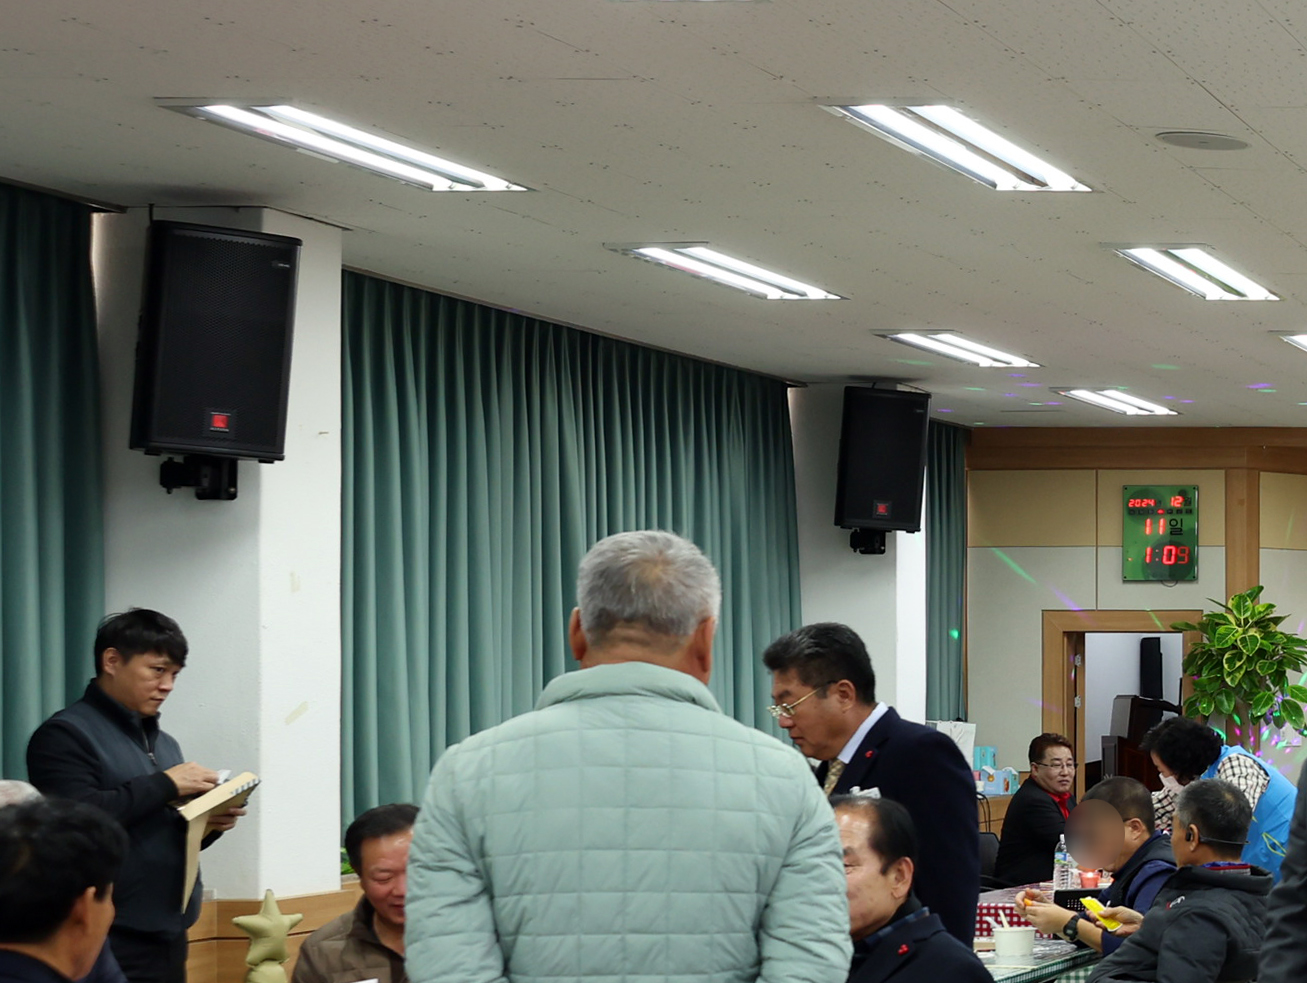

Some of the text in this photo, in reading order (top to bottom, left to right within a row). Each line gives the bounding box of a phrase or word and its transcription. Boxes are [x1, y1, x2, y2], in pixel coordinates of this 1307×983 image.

[1128, 498, 1157, 507] 2024
[1170, 495, 1185, 508] 12
[1144, 517, 1184, 535] 11 일
[1144, 544, 1190, 565] 1:09
